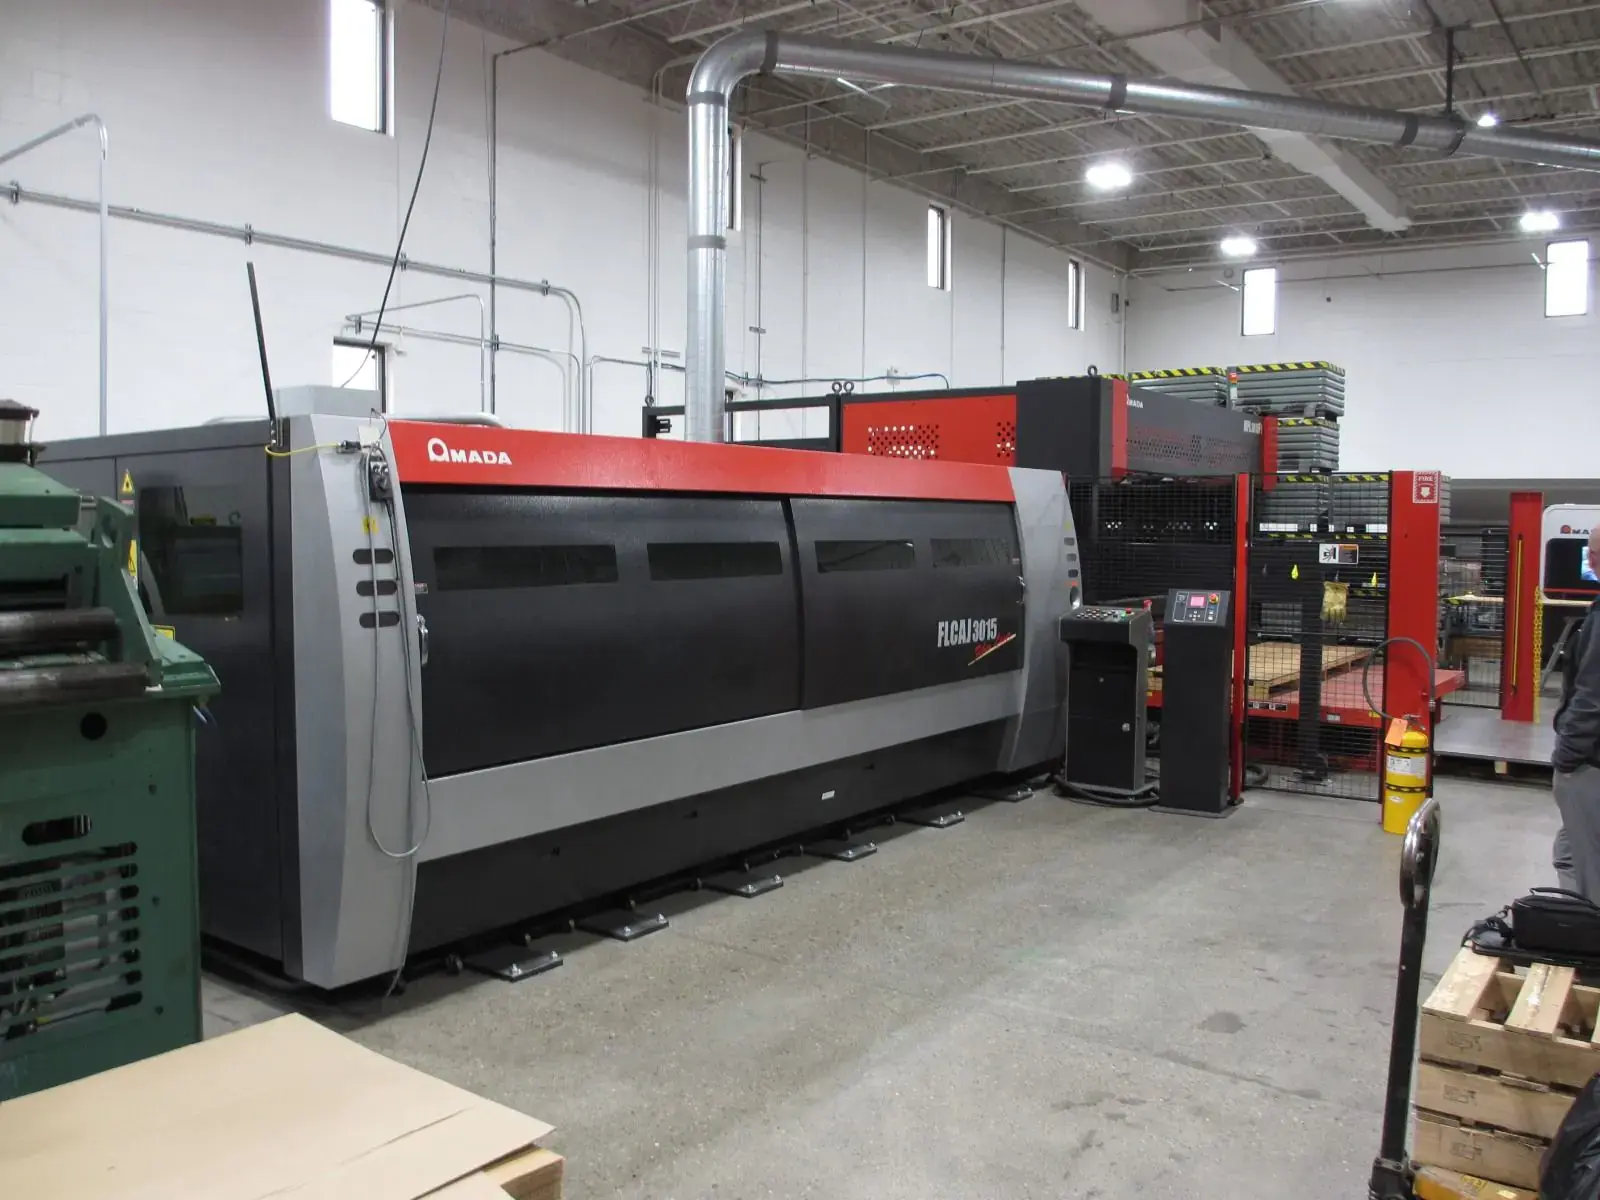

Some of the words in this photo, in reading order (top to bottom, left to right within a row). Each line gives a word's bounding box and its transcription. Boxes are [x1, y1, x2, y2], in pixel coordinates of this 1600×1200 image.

[427, 437, 513, 465] AMADA
[1560, 524, 1590, 535] AMA
[972, 617, 998, 642] 3015
